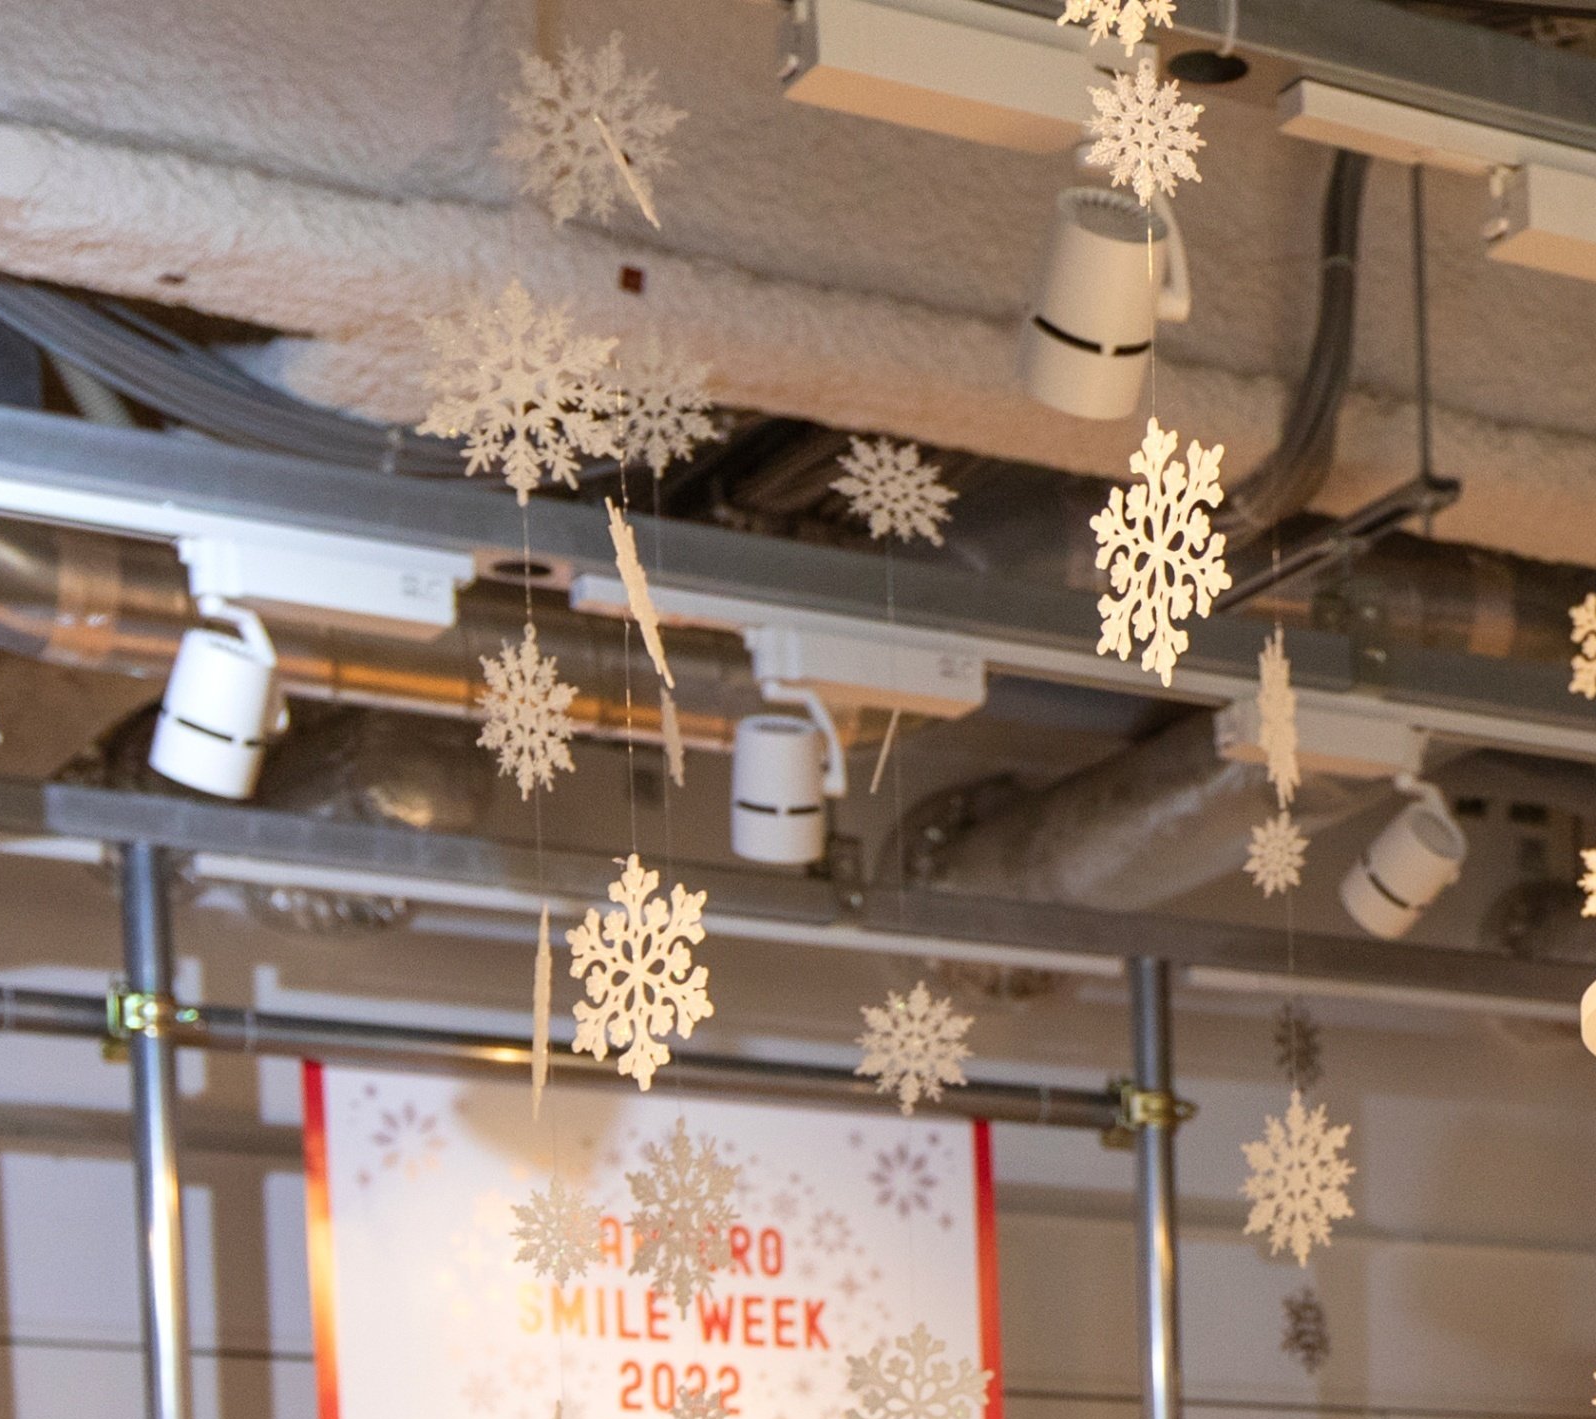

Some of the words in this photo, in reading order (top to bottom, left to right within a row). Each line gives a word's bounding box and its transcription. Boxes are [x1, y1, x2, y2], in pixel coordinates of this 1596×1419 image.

[517, 1287, 670, 1342] SMILE
[696, 1293, 831, 1351] WEEK
[618, 1362, 742, 1416] 2022
